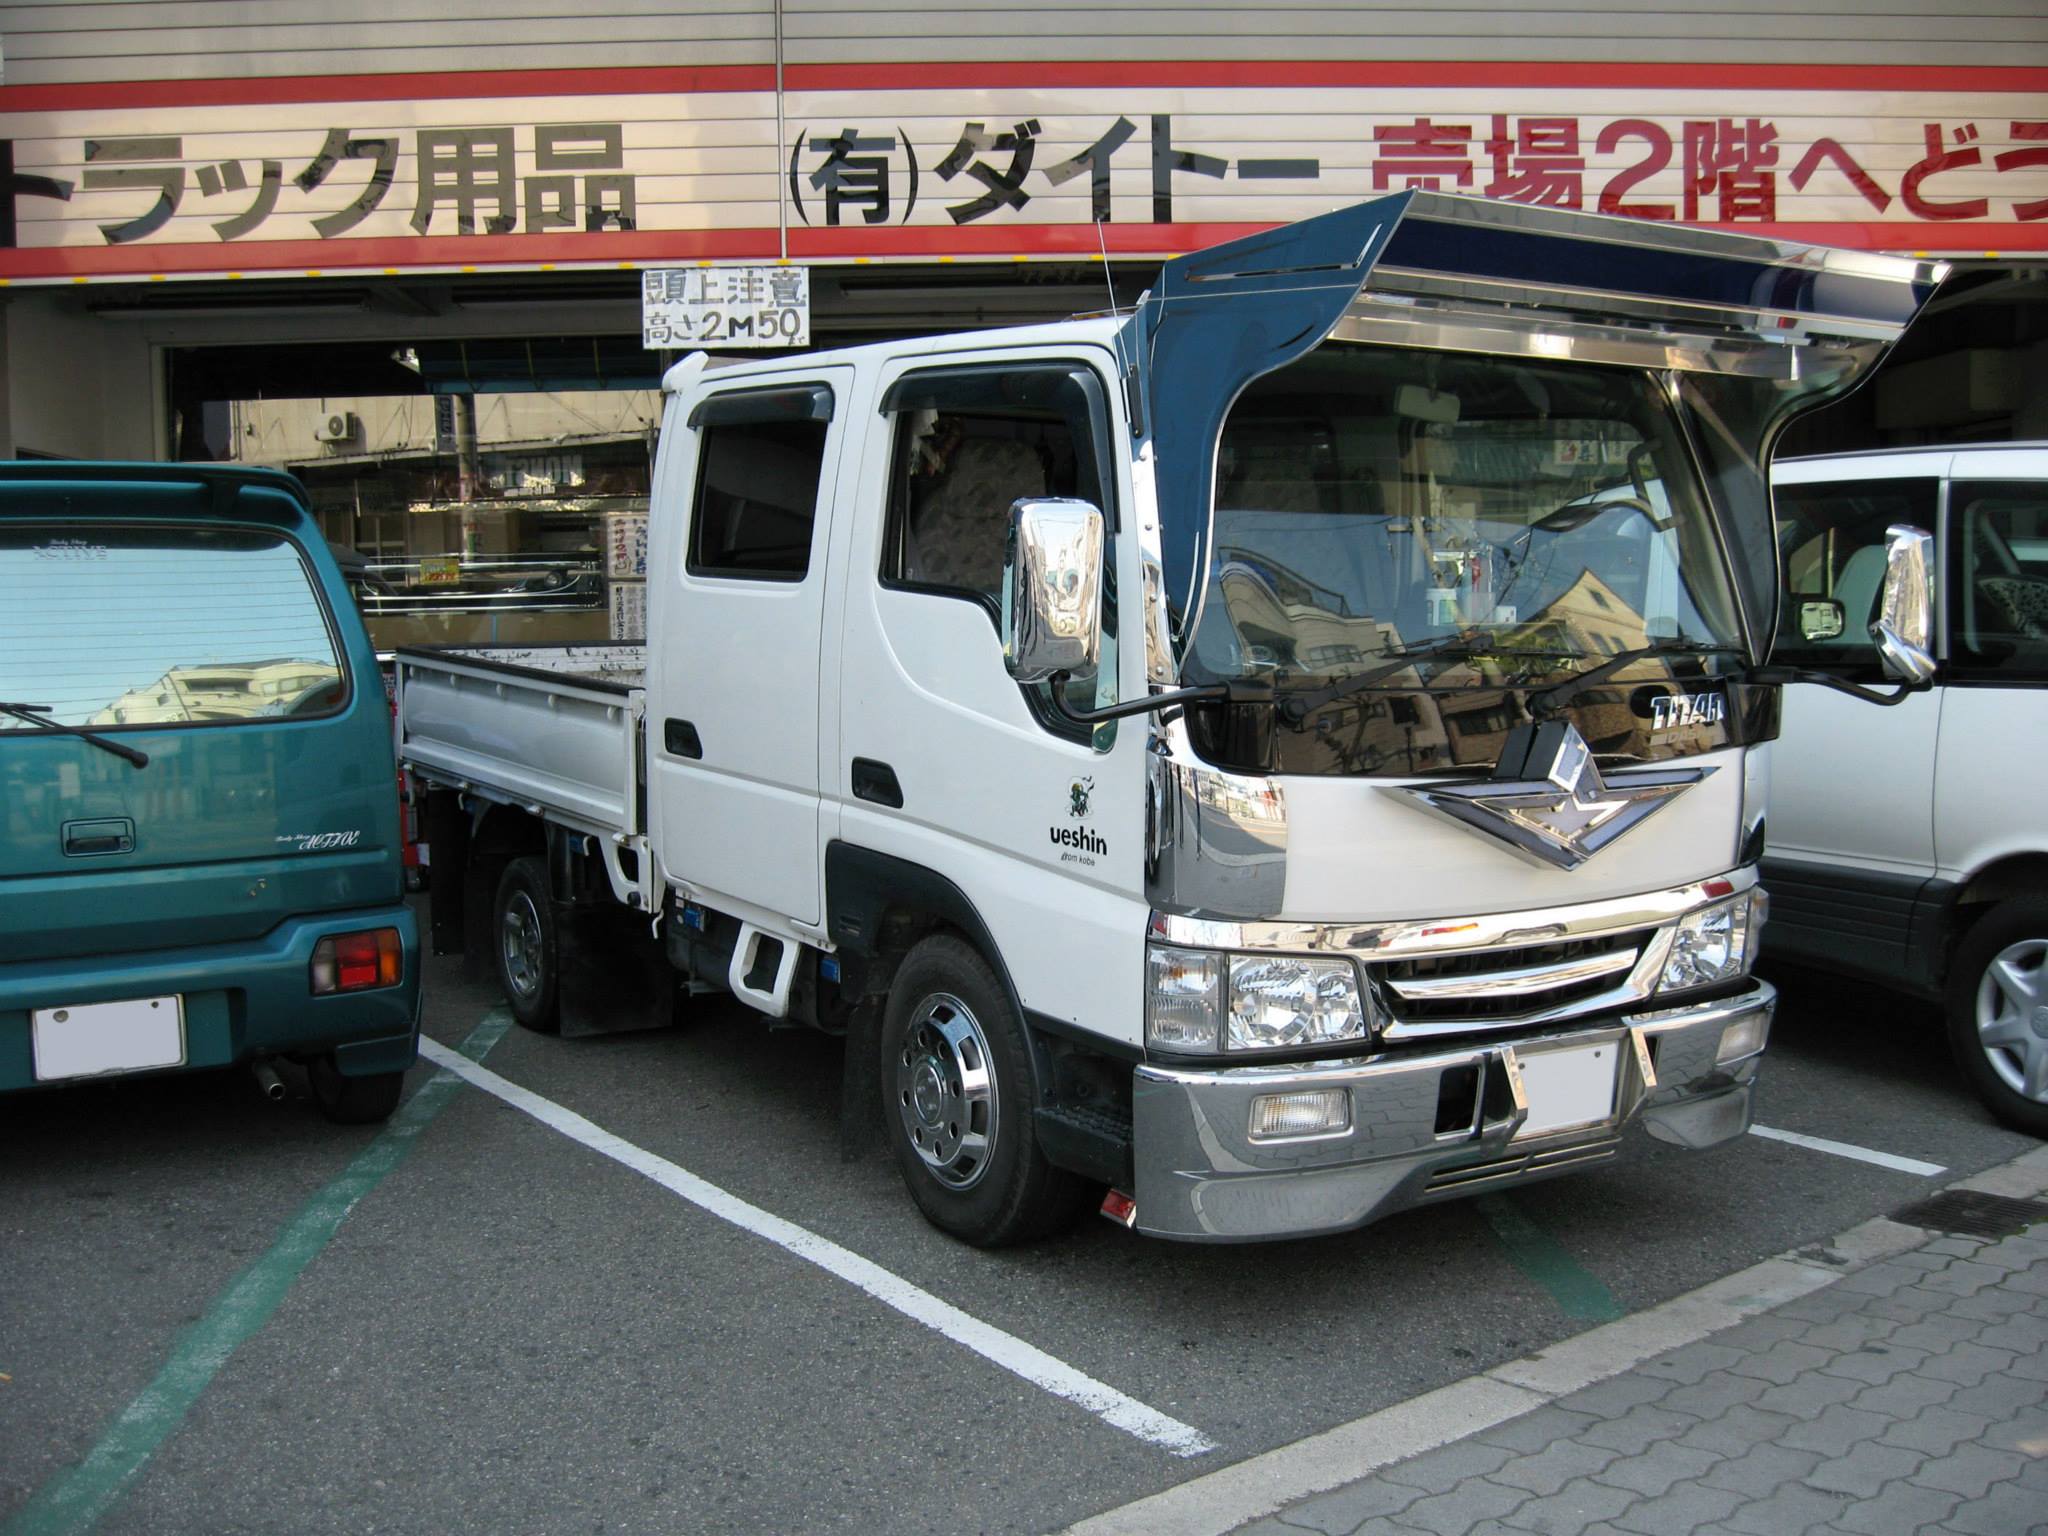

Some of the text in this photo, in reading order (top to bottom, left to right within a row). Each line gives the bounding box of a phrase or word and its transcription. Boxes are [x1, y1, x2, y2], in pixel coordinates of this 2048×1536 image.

[645, 269, 807, 308] 頭上注意
[1050, 825, 1108, 856] ueshin
